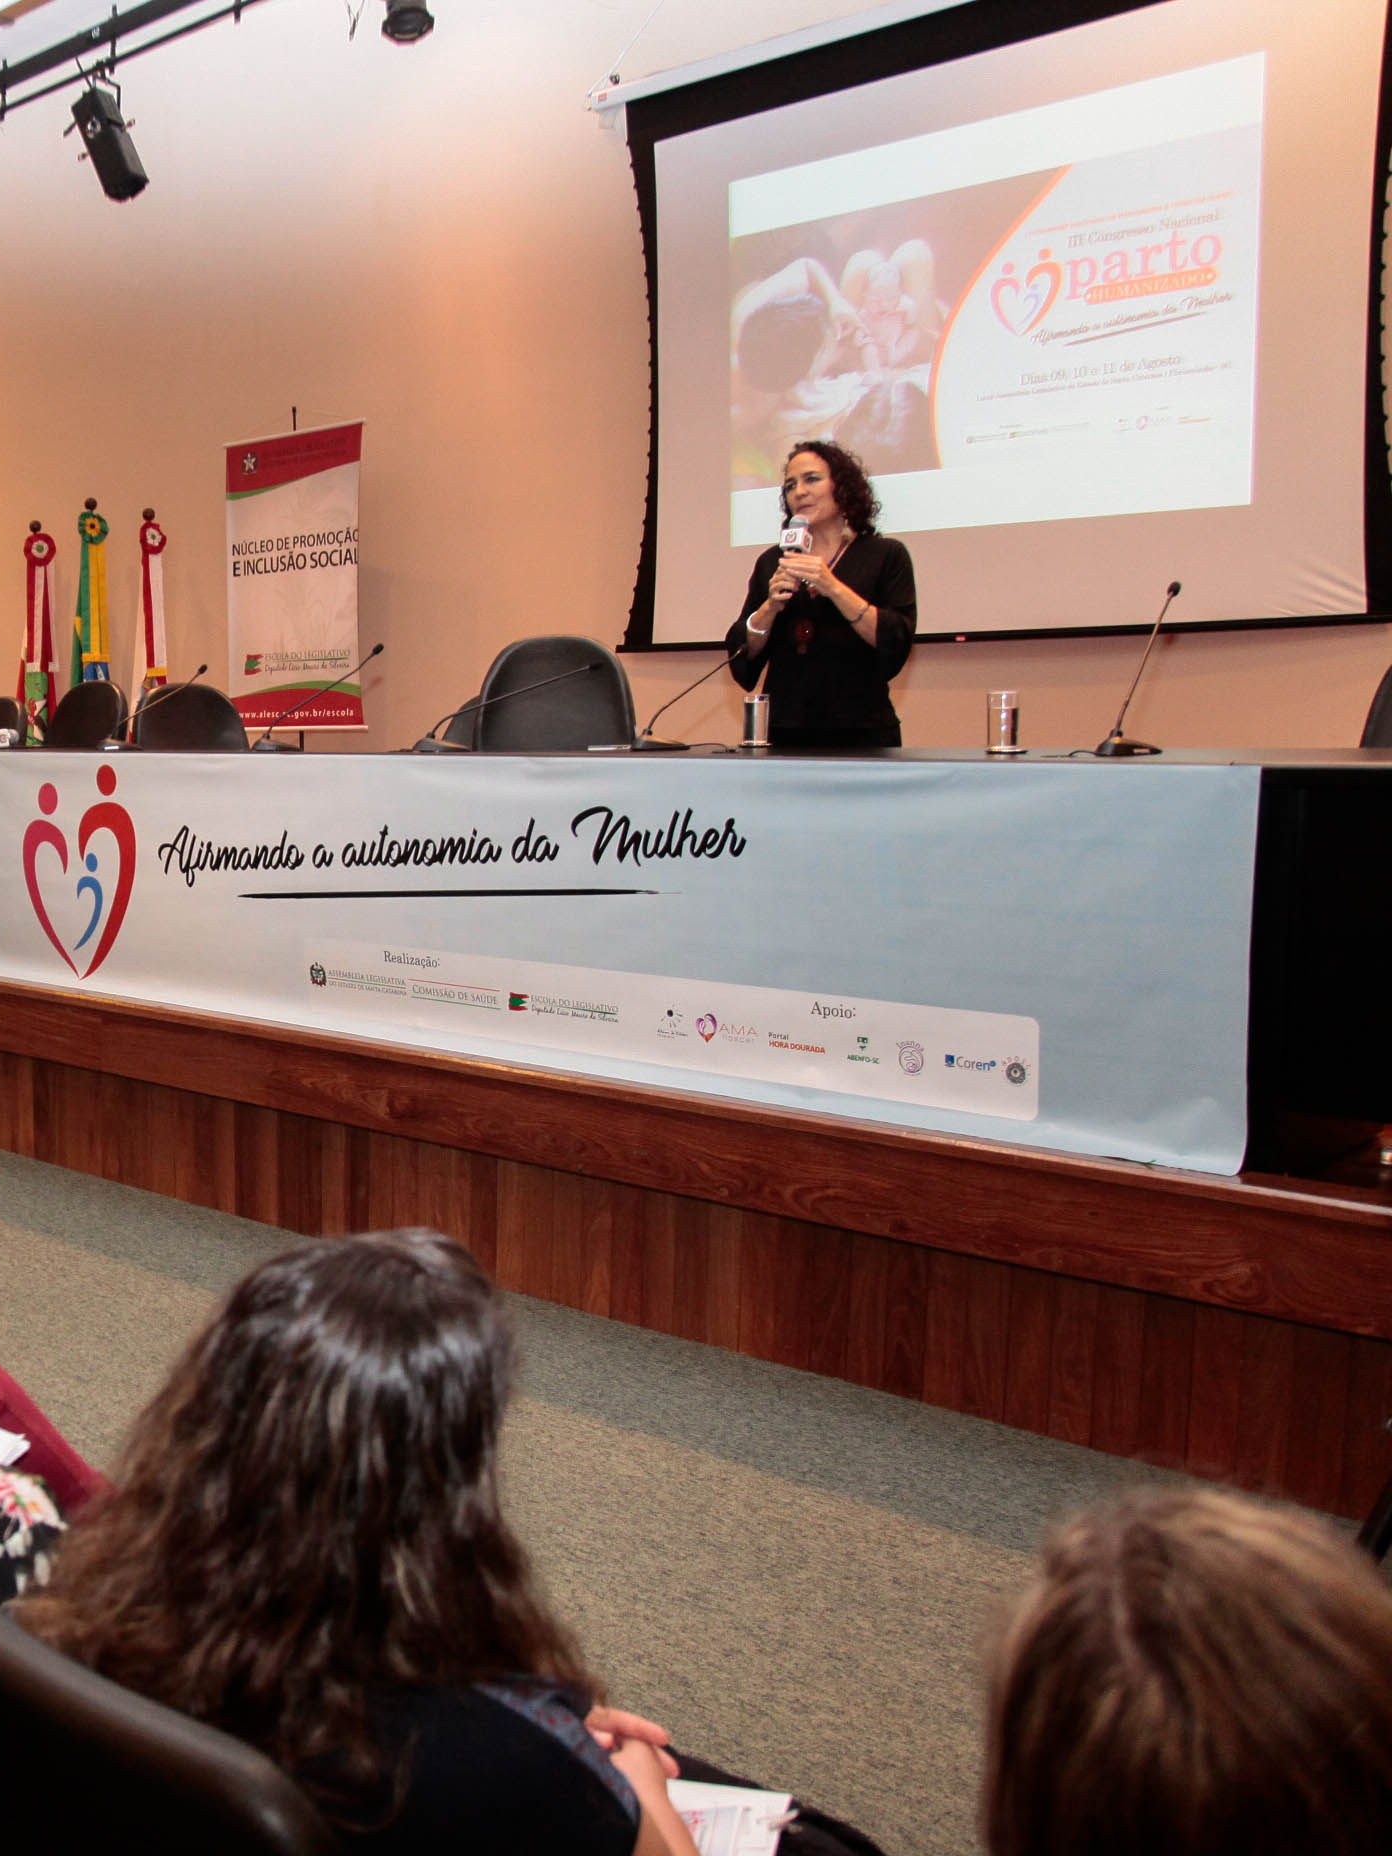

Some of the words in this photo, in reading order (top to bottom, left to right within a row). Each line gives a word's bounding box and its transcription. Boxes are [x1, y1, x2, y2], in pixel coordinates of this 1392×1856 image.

[1065, 231, 1222, 300] parto
[1092, 273, 1205, 301] HUMANIZADO
[232, 539, 274, 556] NÚCLEO
[276, 537, 290, 551] DE
[292, 527, 358, 548] PROMOÇÃO
[232, 561, 241, 577] E
[243, 551, 307, 577] INCLUSÃO
[309, 547, 358, 569] SOCIAL
[158, 825, 305, 888] Afirmando
[312, 842, 334, 868] a
[341, 825, 503, 868] autonomia
[511, 818, 560, 864] da
[571, 805, 747, 868] Mulher
[383, 950, 441, 968] Realização:
[412, 984, 456, 999] COMISSÃO
[458, 991, 468, 1001] DE
[558, 998, 570, 1007] DO
[810, 1001, 857, 1020] Apoio:
[719, 1023, 757, 1036] AMA
[768, 1031, 789, 1041] Portal
[768, 1040, 789, 1049] HORA
[791, 1042, 826, 1054] DOURADA
[956, 1056, 991, 1071] Coren
